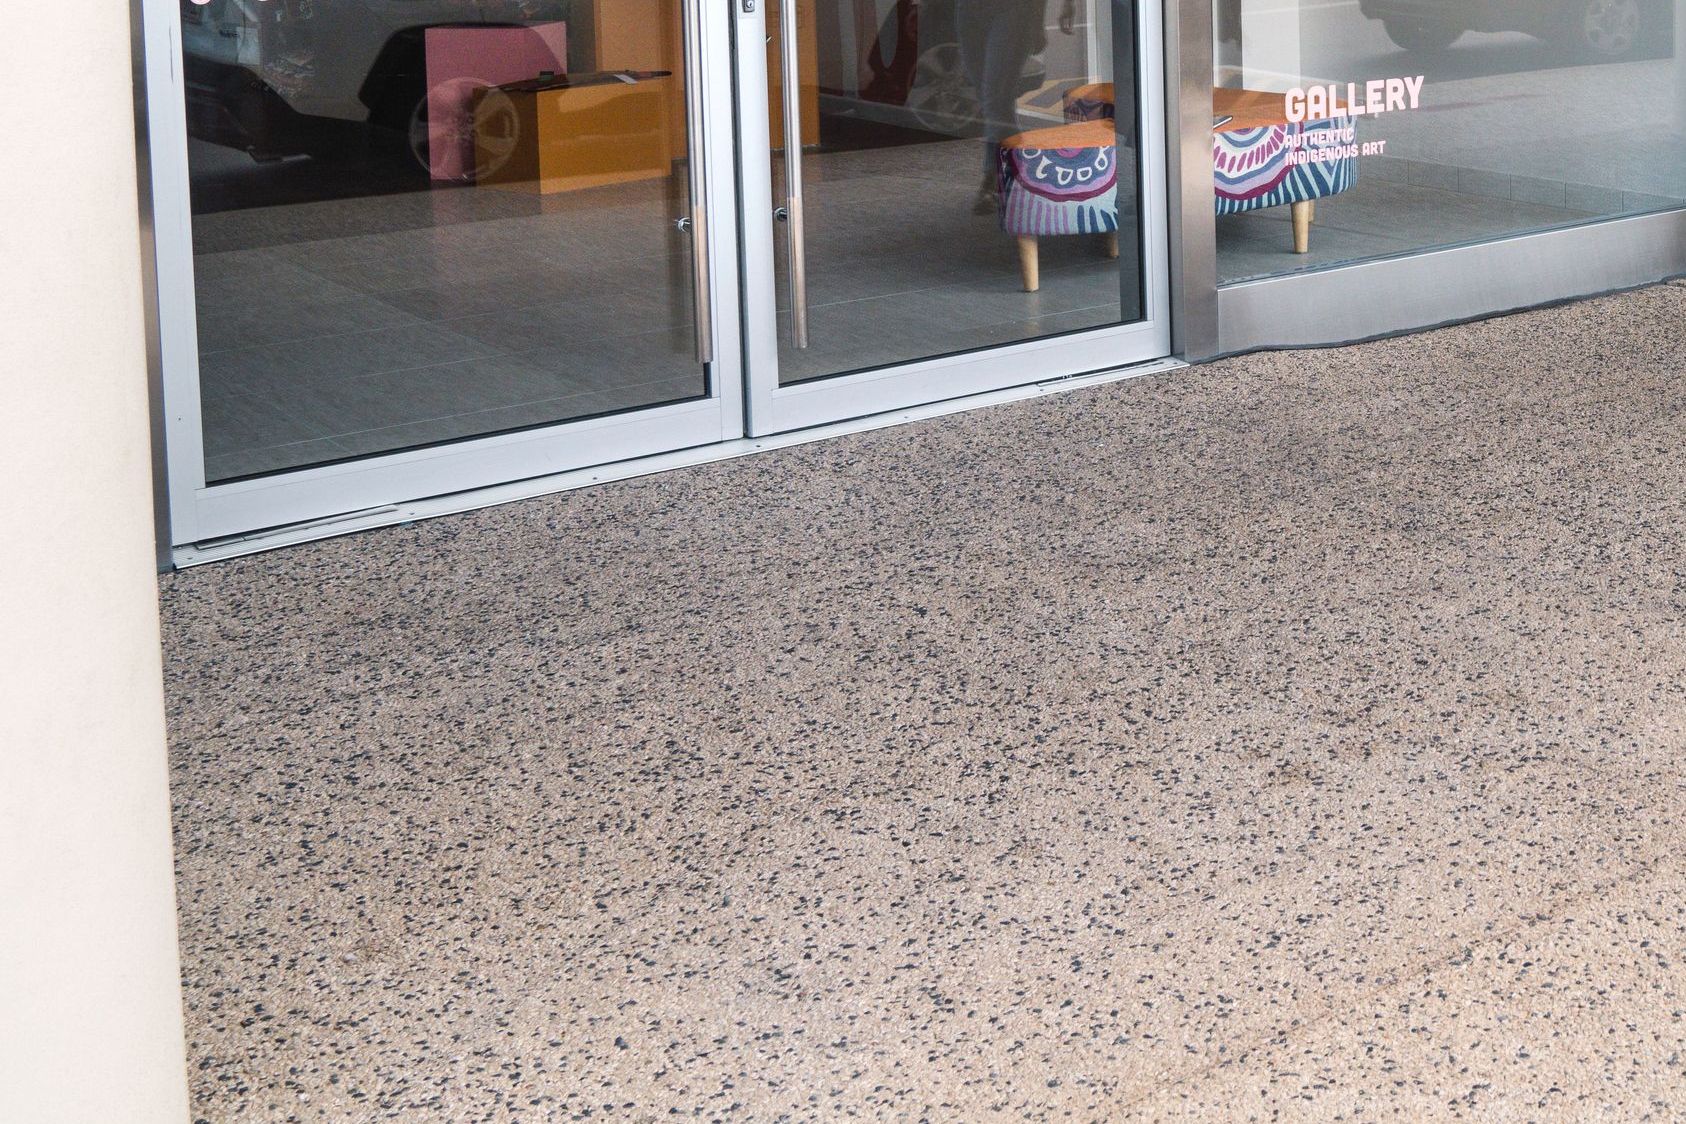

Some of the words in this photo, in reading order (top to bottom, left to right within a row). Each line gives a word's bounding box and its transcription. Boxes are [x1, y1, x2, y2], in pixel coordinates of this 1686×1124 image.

[1285, 75, 1424, 123] GALLERY
[1285, 127, 1354, 148] AUTHENTIC
[1285, 144, 1359, 165] INDIGENOUS
[1362, 140, 1386, 156] ART
